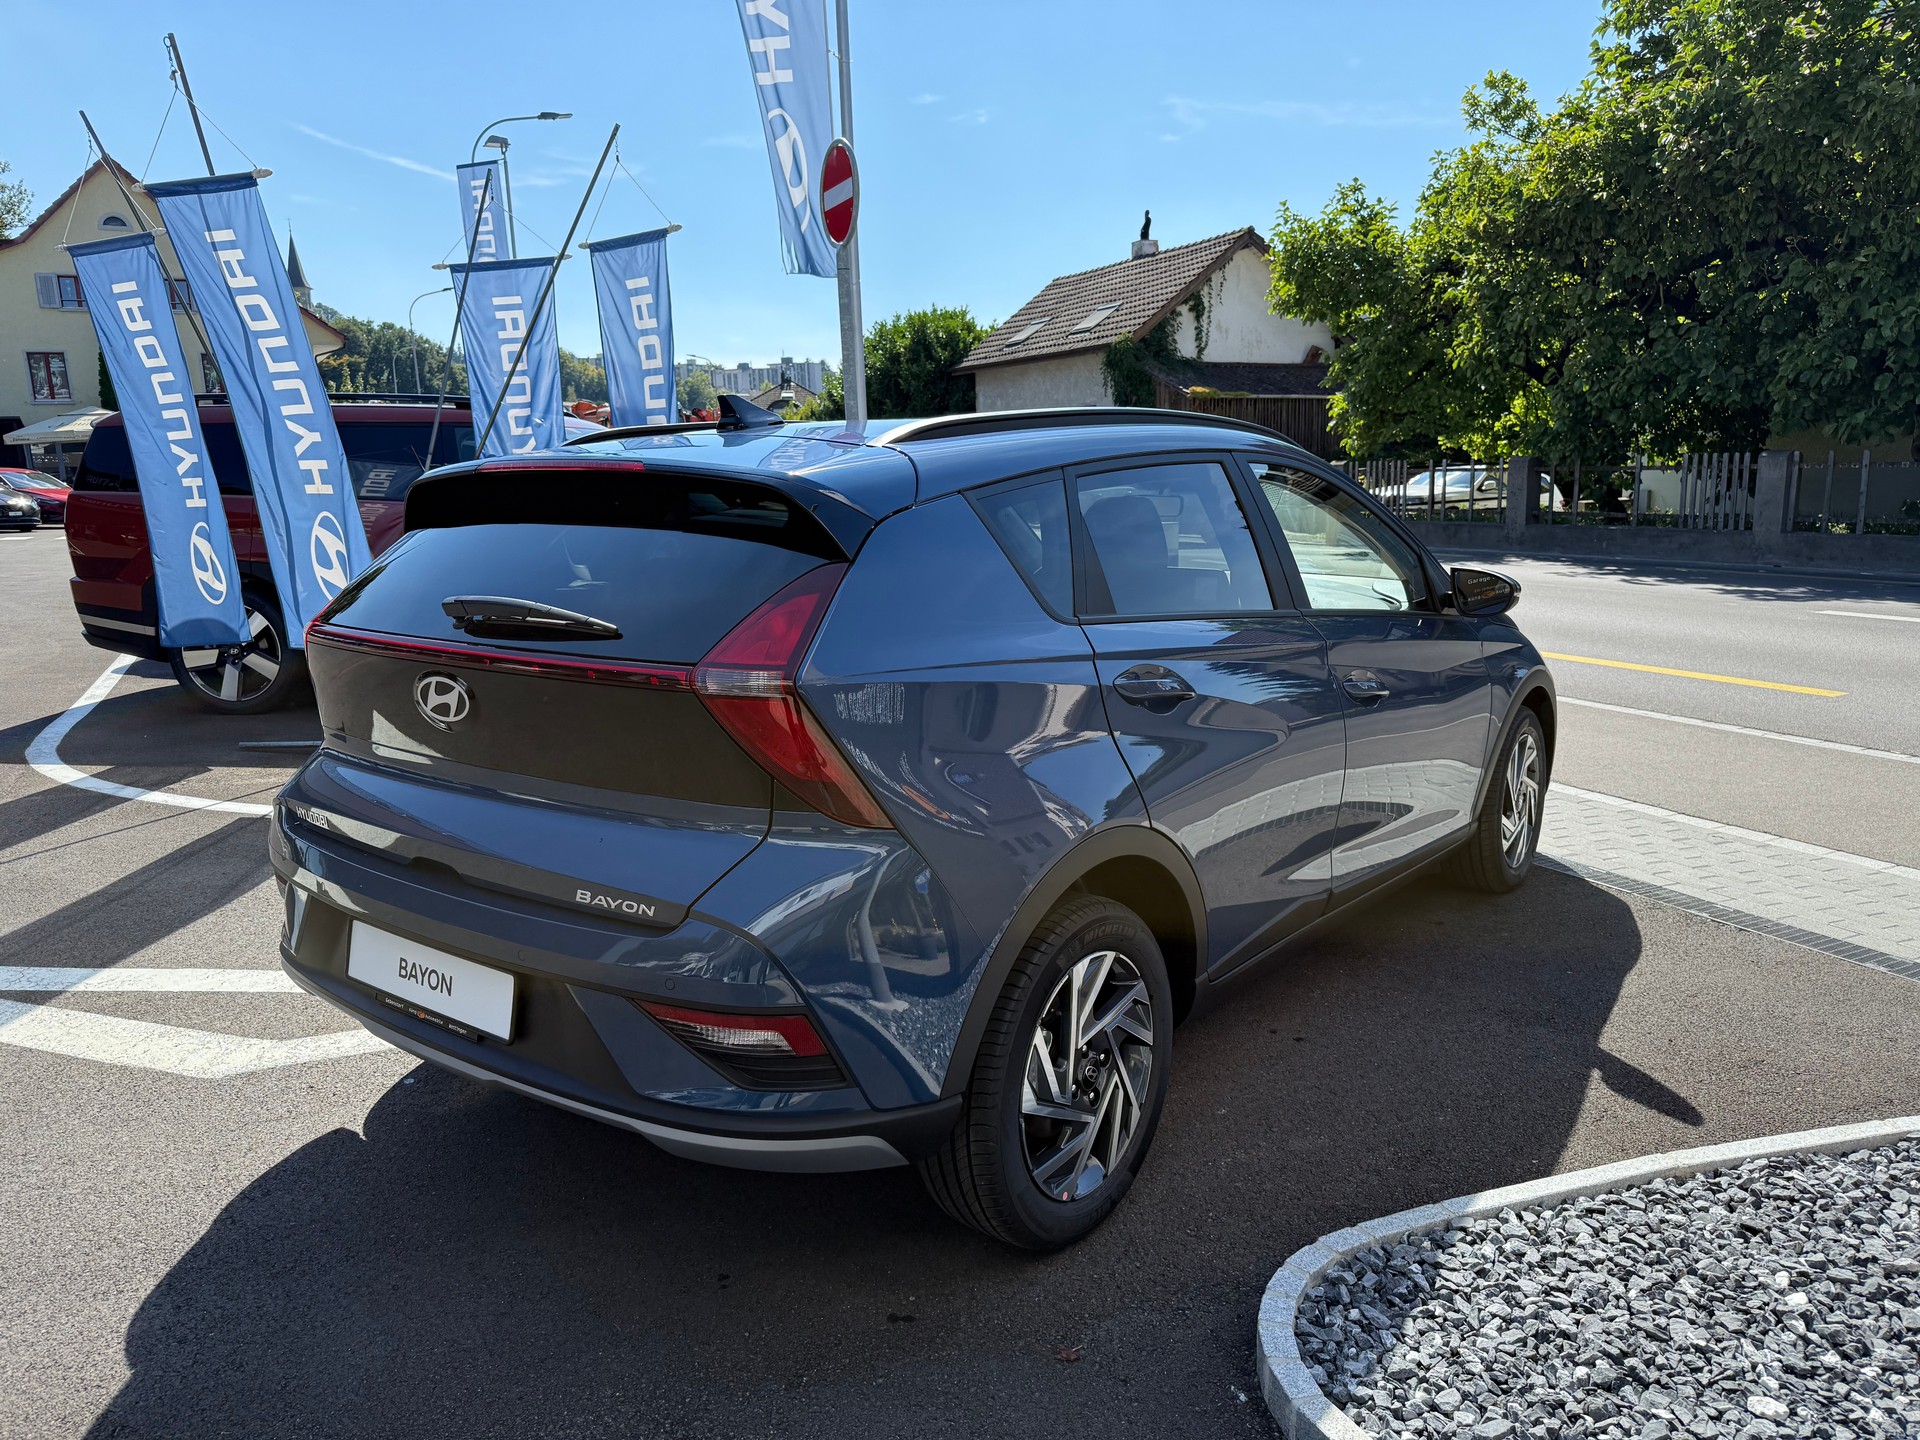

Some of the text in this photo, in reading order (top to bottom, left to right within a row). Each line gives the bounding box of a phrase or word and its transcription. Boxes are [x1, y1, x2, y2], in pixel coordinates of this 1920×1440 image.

[203, 228, 334, 495] HYUNDAI
[111, 280, 207, 508] HYUNDAI
[295, 805, 330, 830] HYUNDAI
[575, 888, 656, 918] BAYON
[1083, 924, 1137, 943] MICHELIN
[398, 956, 453, 997] BAYON
